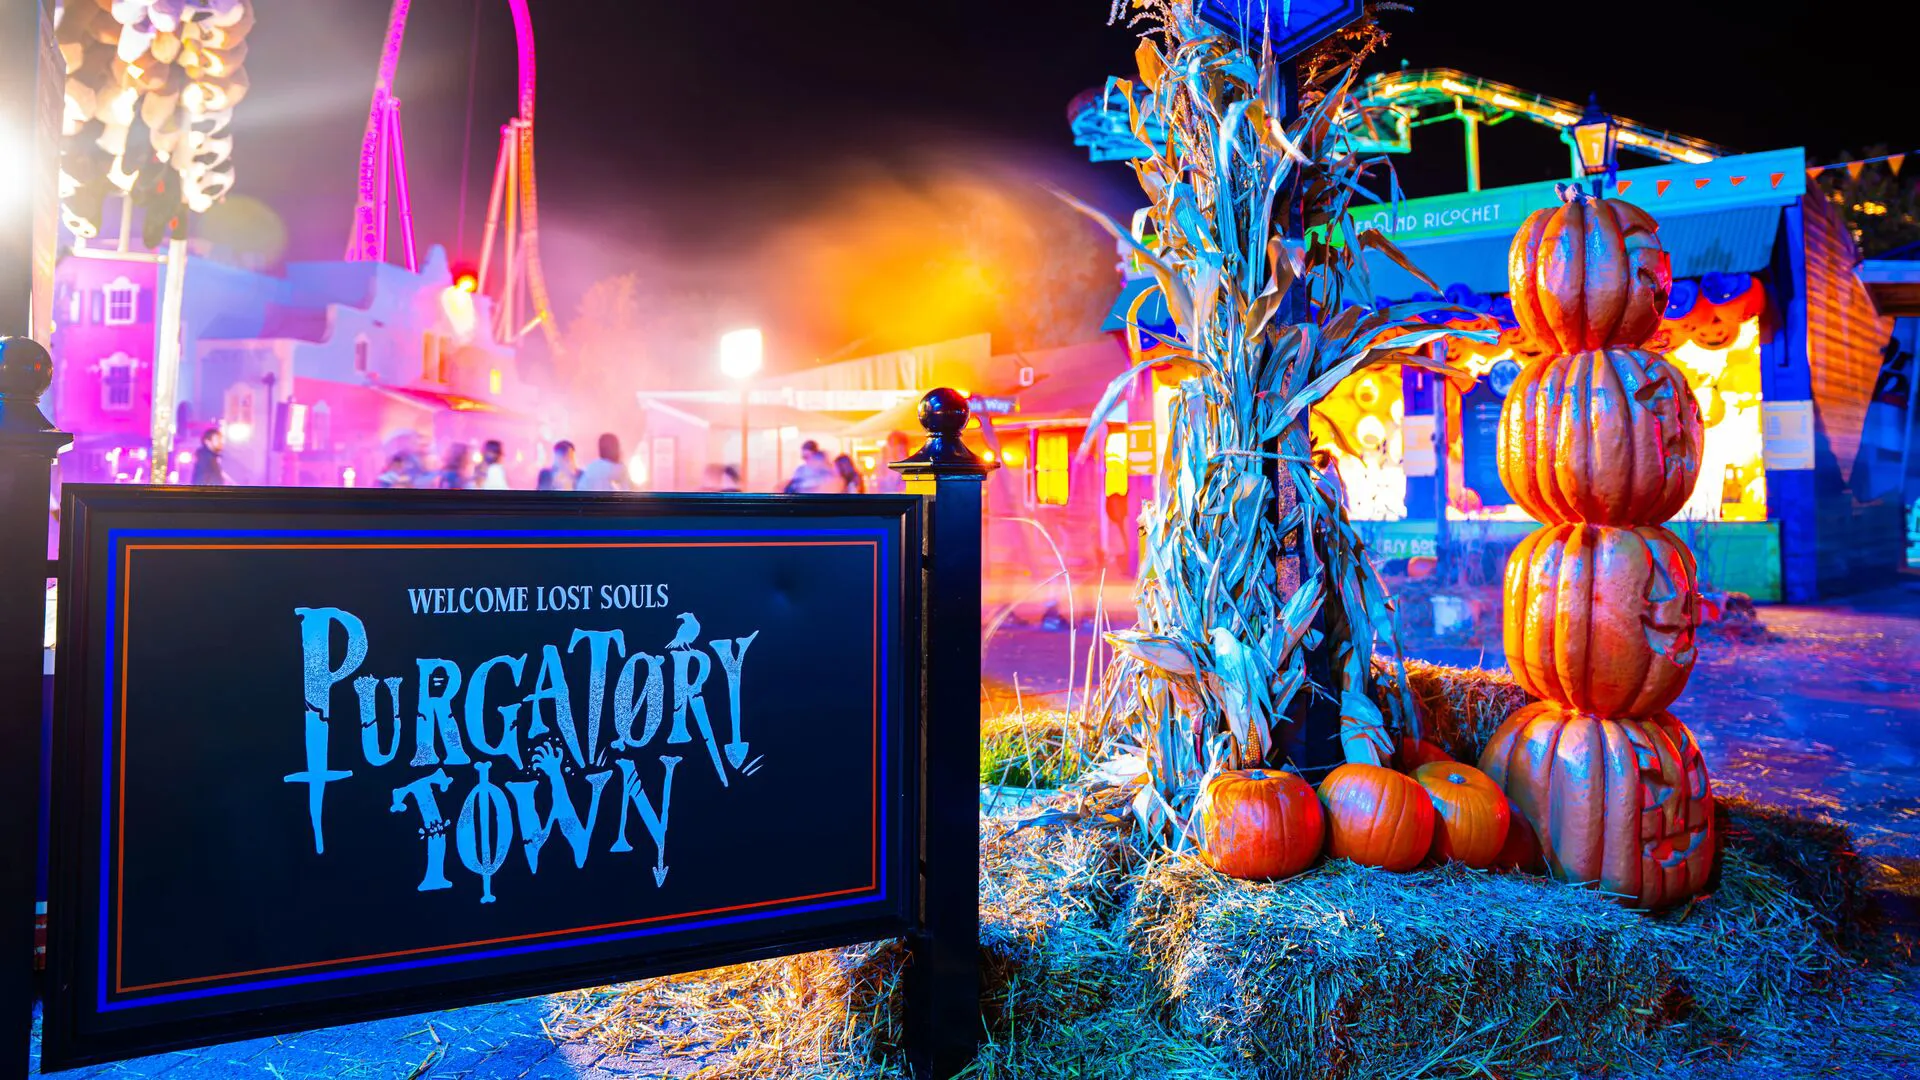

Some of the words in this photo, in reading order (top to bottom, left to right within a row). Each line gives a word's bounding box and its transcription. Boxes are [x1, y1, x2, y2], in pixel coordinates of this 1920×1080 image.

[1355, 212, 1417, 236] EBOUND
[1424, 204, 1500, 228] RICOCHET
[984, 398, 1010, 414] Way
[408, 586, 529, 615] WELCOME
[536, 585, 593, 611] LOST
[600, 583, 669, 610] SOULS
[284, 607, 759, 854] PURGATORY
[390, 754, 683, 903] TOWN
